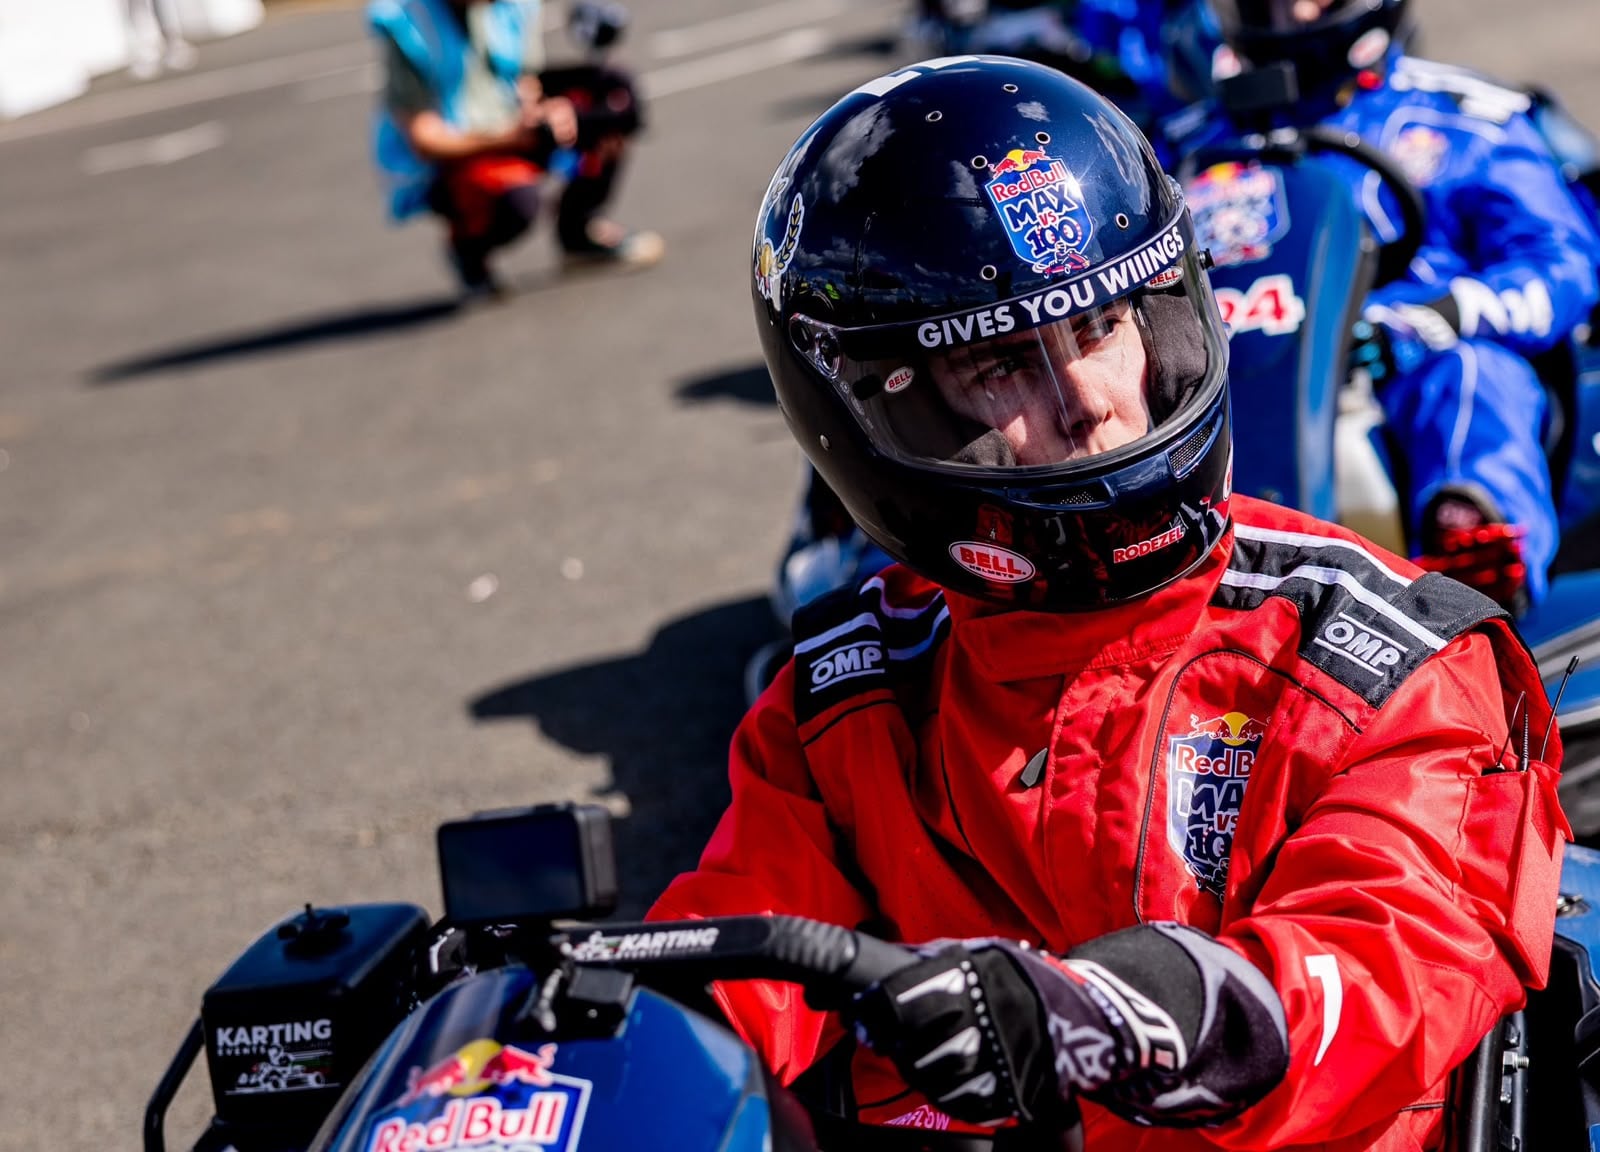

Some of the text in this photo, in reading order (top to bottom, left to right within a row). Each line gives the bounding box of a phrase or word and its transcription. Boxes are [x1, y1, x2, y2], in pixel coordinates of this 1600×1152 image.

[992, 161, 1069, 202] Red Bull
[1004, 182, 1078, 231] MAX
[1024, 217, 1082, 258] 100
[917, 226, 1184, 348] GIVES YOU WIIINGS
[888, 371, 911, 388] BELL
[960, 546, 1022, 575] BELL
[1113, 525, 1184, 563] RODEZEL
[969, 564, 1014, 579] HELMETS
[1325, 621, 1400, 667] OMP
[812, 646, 882, 685] OMP
[1177, 745, 1233, 777] Red
[1177, 778, 1248, 821] MA
[616, 927, 720, 955] KARTING
[216, 1019, 332, 1047] KARTING
[460, 1093, 567, 1144] Bull
